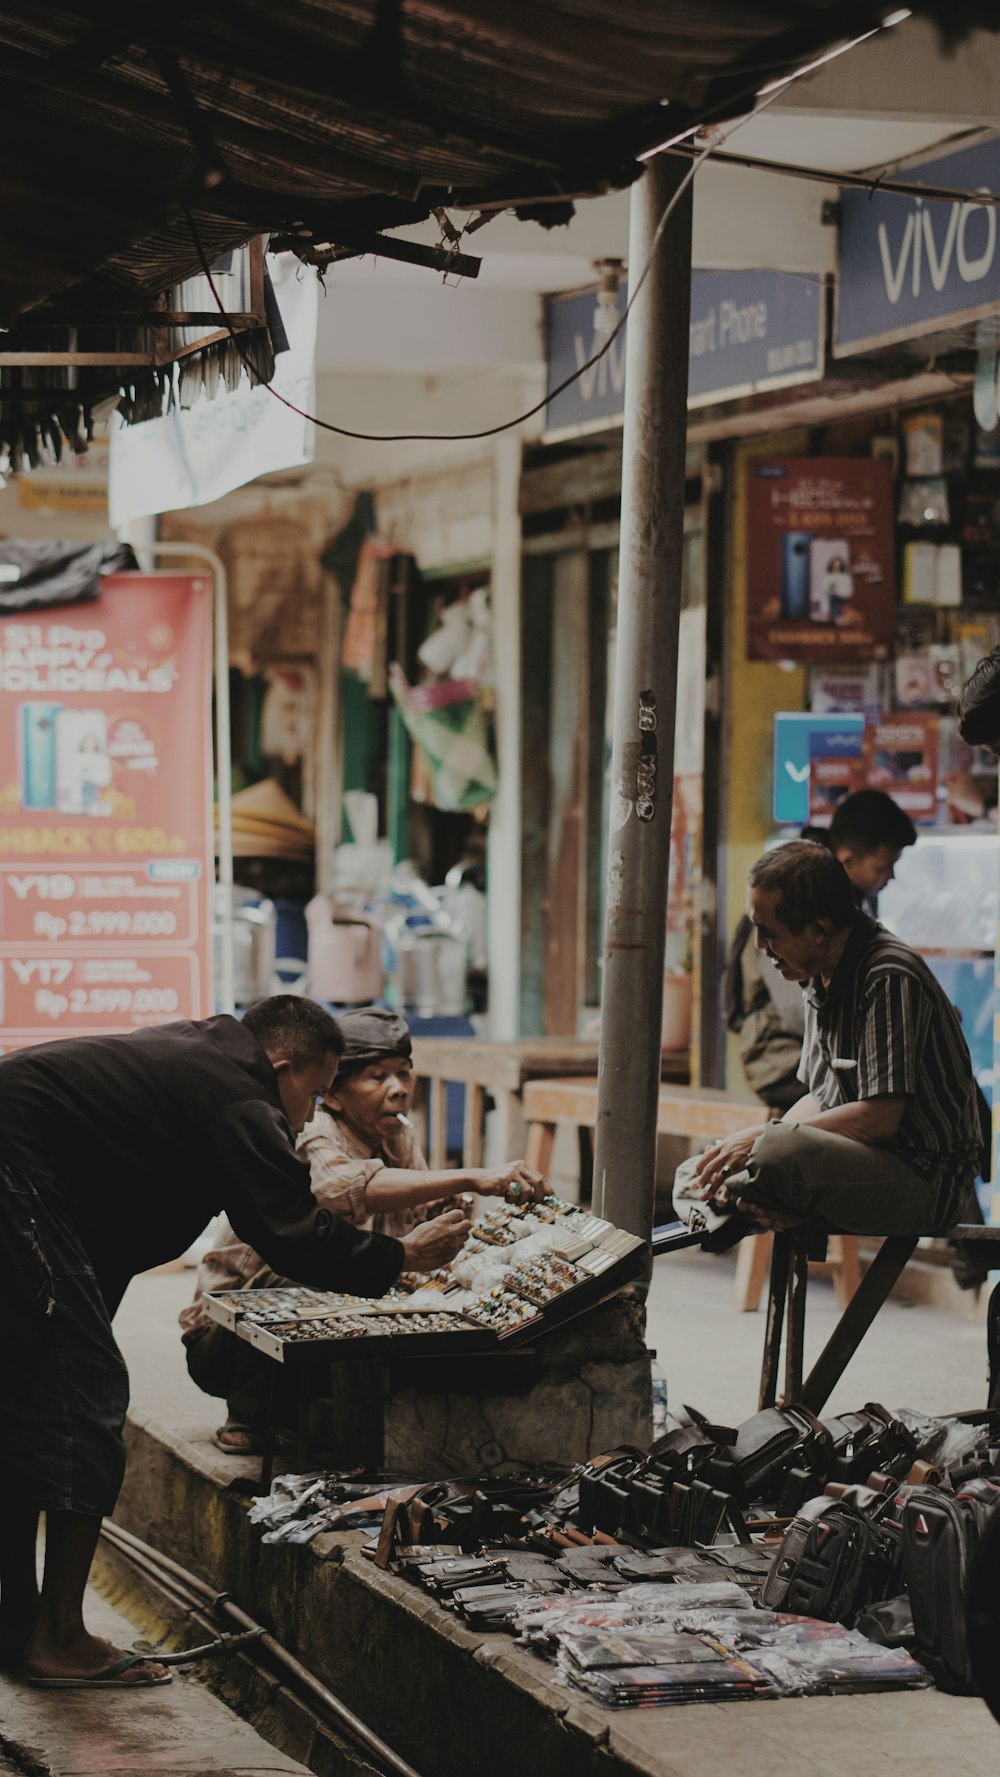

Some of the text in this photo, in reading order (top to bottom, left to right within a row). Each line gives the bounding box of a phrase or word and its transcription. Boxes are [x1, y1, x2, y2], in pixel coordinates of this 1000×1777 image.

[720, 301, 768, 347] Phone
[573, 318, 626, 402] viv
[4, 624, 106, 650] S1 Pro
[0, 648, 97, 671] APPY
[0, 668, 173, 692] OLIDEALS
[7, 875, 75, 900] Y19
[34, 911, 177, 940] Rp 2.999.000
[10, 959, 73, 985] Y17
[35, 989, 69, 1019] Rp
